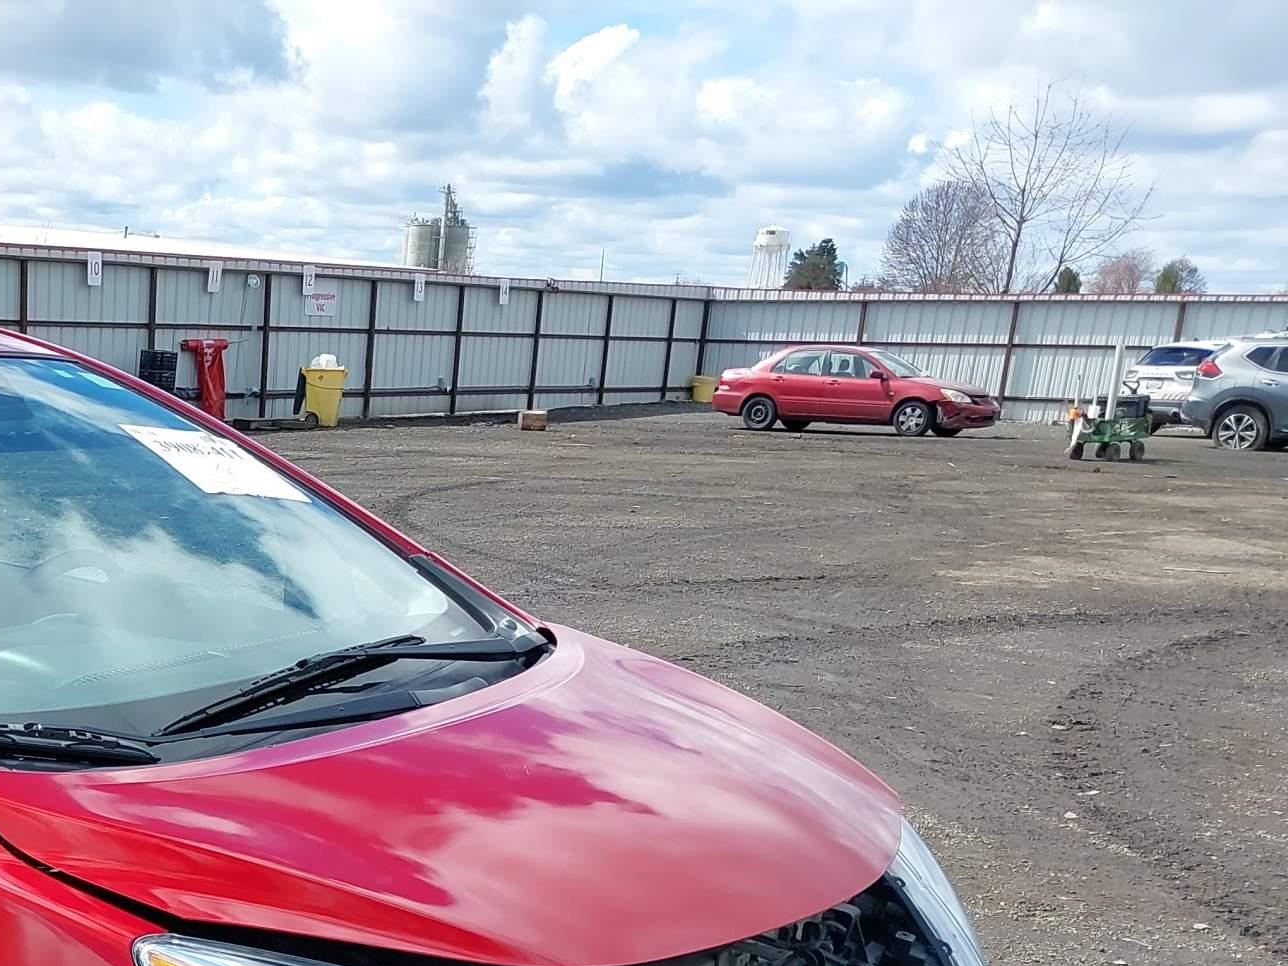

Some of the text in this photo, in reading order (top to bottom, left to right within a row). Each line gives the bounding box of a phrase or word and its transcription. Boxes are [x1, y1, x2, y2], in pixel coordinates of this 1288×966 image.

[90, 261, 100, 276] 10
[211, 269, 219, 283] 11
[305, 273, 313, 287] 12
[416, 280, 423, 294] 13
